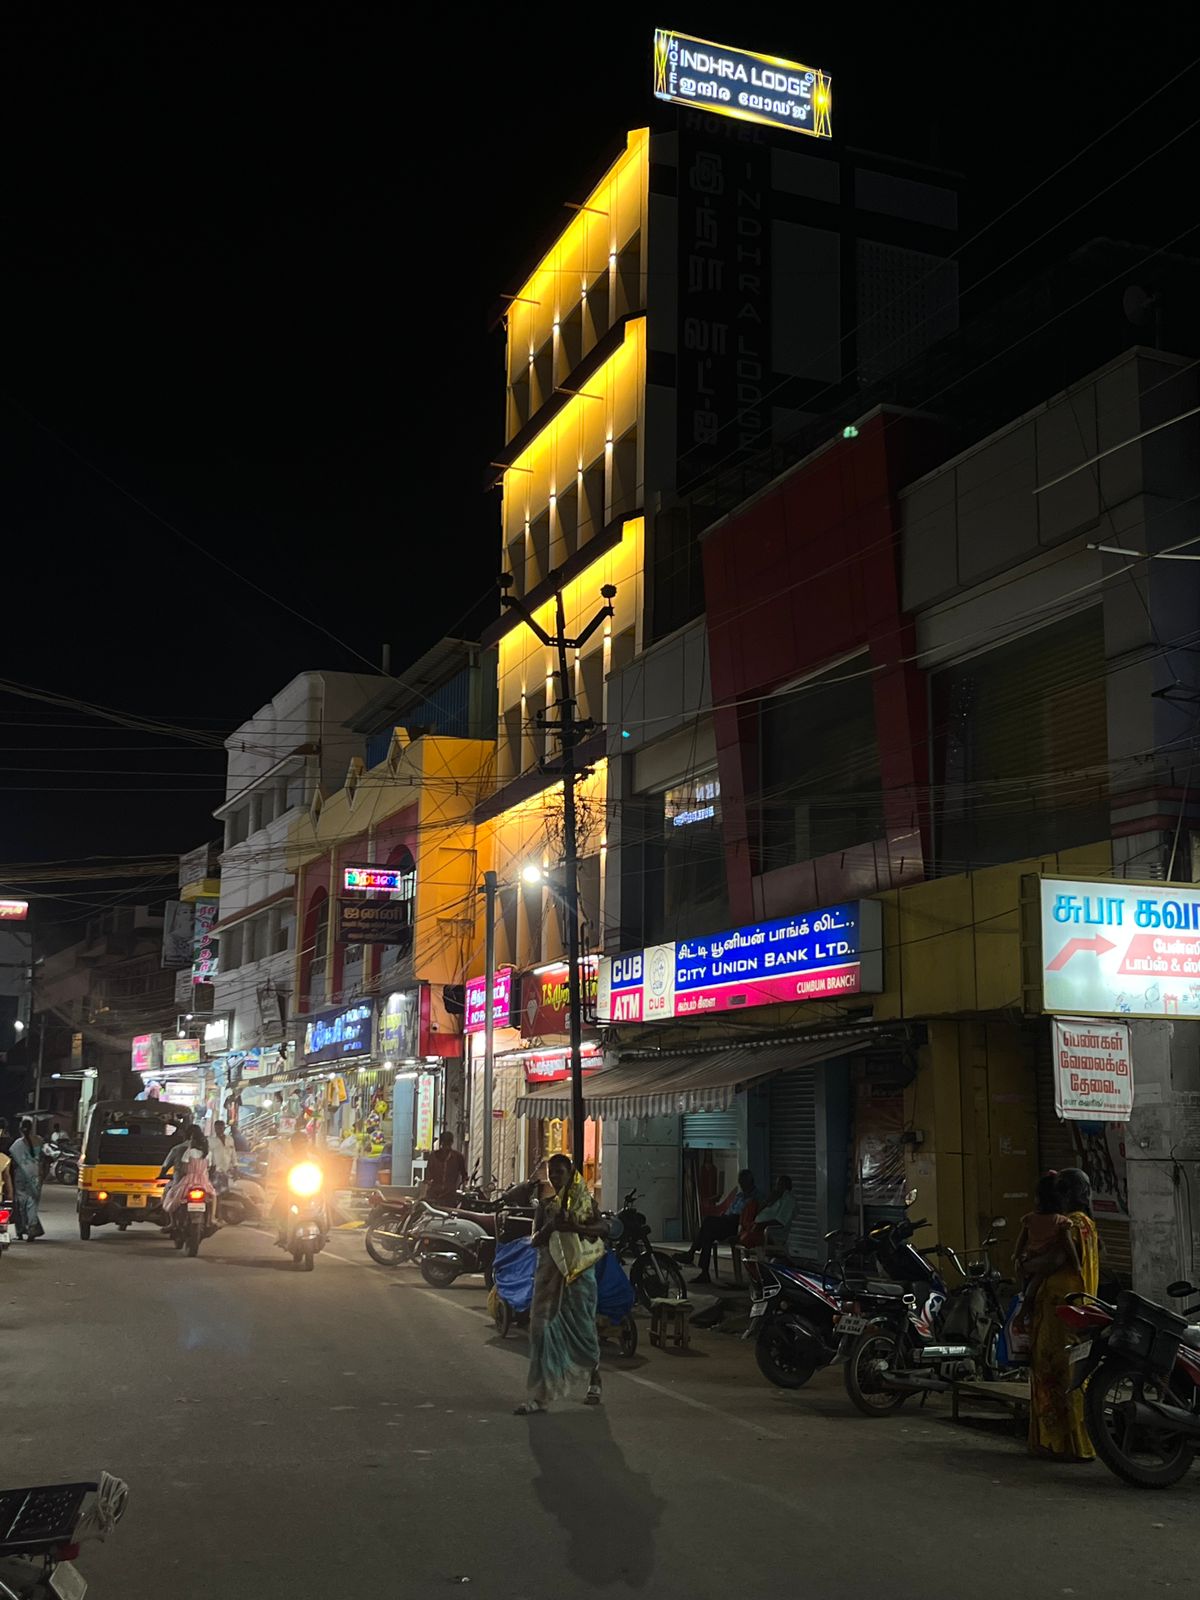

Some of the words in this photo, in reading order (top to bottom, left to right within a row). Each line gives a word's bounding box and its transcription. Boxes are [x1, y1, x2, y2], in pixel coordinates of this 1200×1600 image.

[669, 40, 678, 95] HOTEL
[680, 48, 748, 84] INDHRA
[751, 67, 811, 99] LODGE
[1052, 893, 1125, 927] சுபா
[678, 943, 709, 961] சிட்டி
[711, 928, 766, 958] யூனியன்
[612, 955, 642, 983] CUB
[1170, 957, 1182, 972] &
[796, 978, 826, 994] CUMBUM
[826, 973, 856, 990] BRANCH
[613, 993, 640, 1021] ATM
[648, 996, 665, 1010] CUB
[1063, 1029, 1123, 1051] பெண்கள்
[1060, 1050, 1128, 1076] வேலைக்கு
